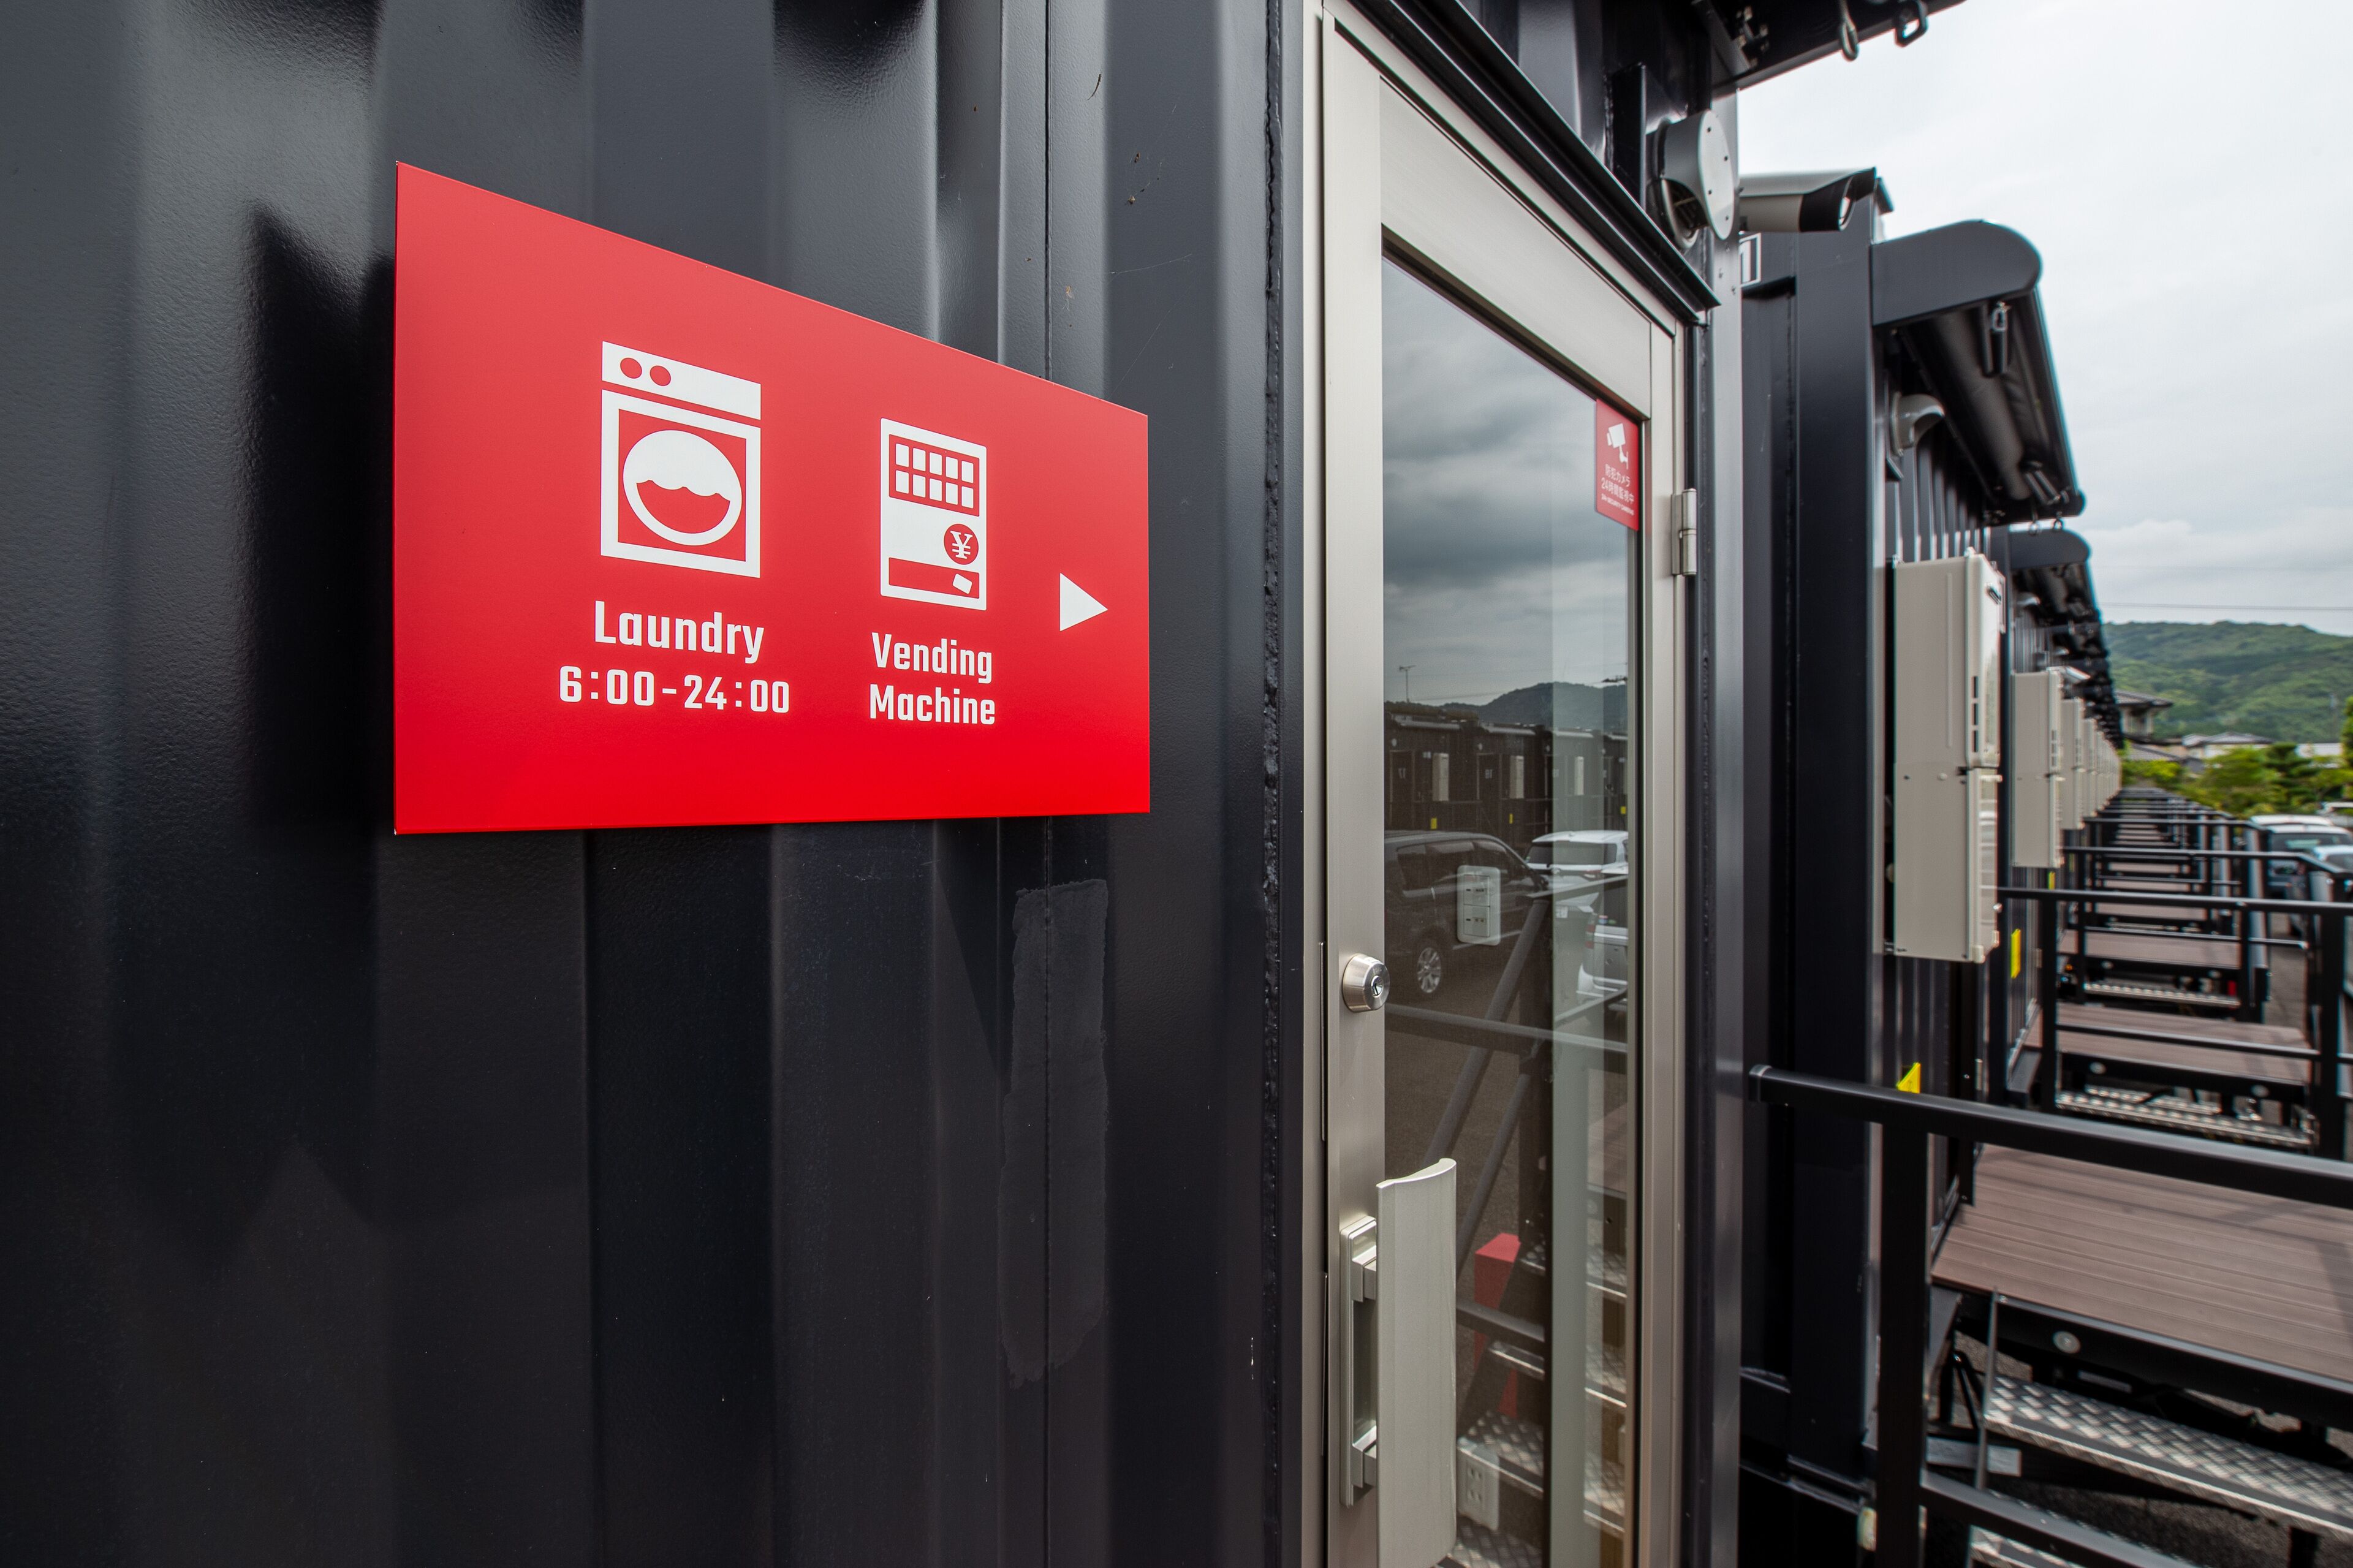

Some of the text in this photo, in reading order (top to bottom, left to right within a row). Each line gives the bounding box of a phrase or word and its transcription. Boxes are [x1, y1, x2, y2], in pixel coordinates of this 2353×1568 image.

[595, 600, 764, 664] Laundry
[871, 632, 992, 684] Vending
[559, 665, 789, 713] 6:00-24:00
[870, 684, 995, 725] Machine
